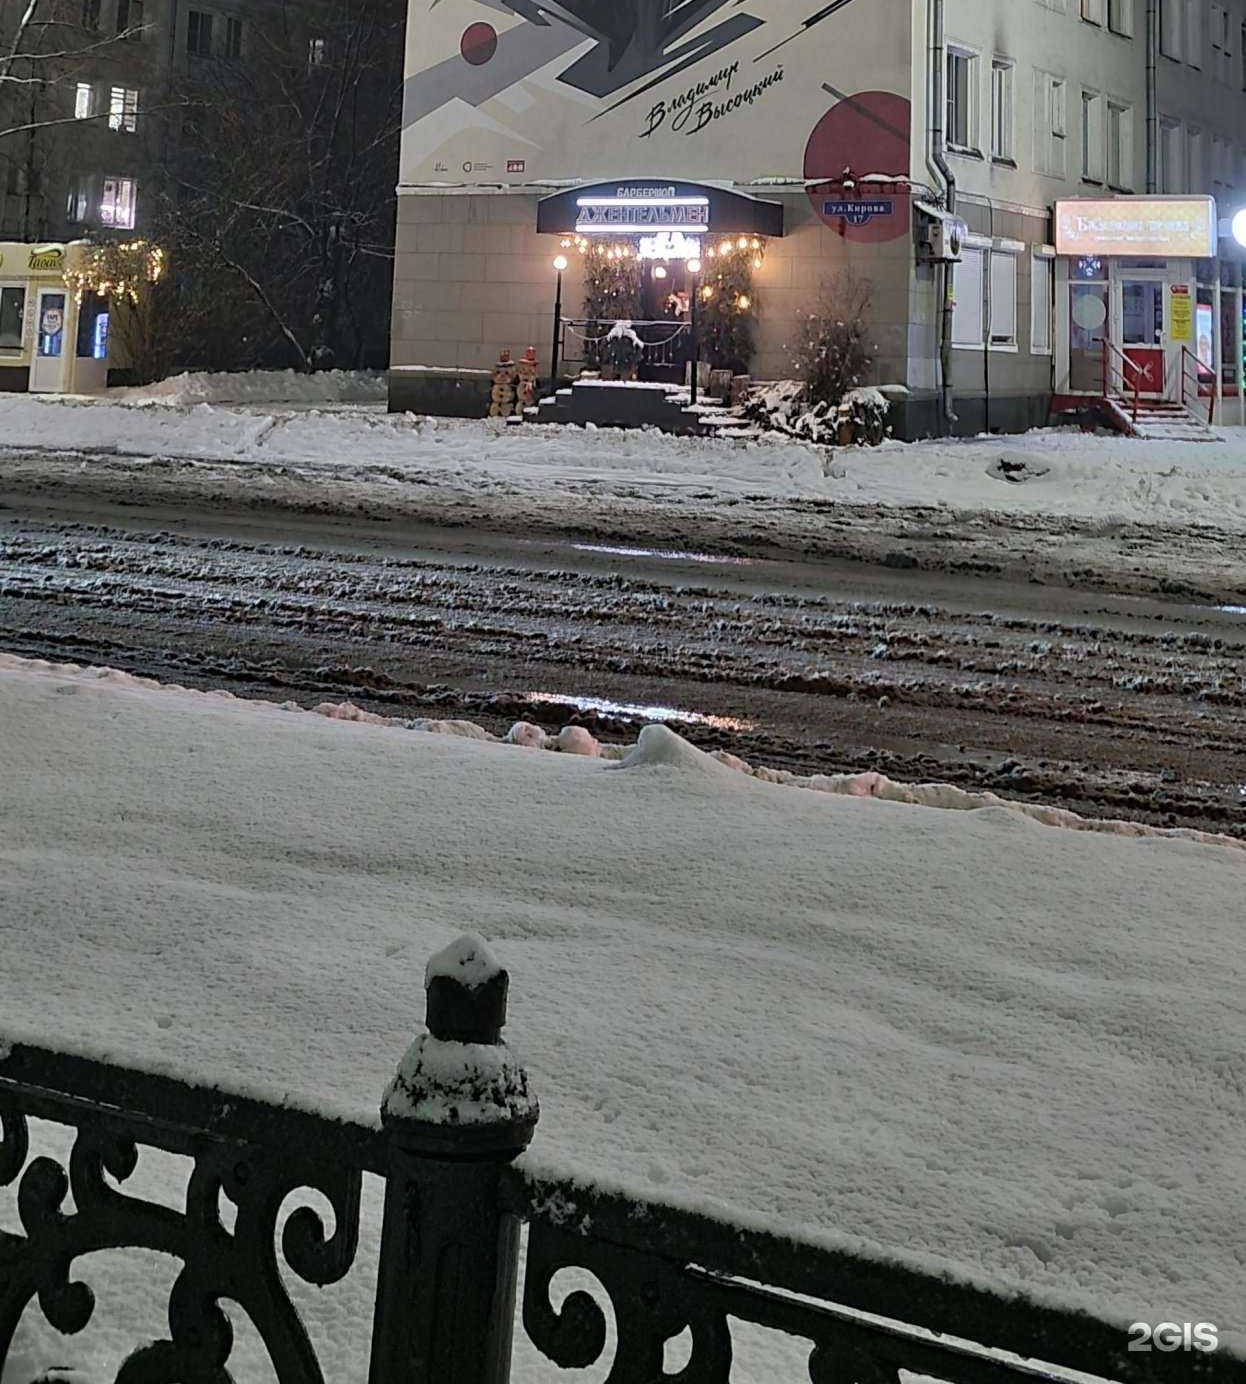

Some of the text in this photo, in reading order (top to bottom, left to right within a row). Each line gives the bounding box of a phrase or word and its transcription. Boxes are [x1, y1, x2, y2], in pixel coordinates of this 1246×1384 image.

[638, 61, 739, 138] Владимир
[685, 64, 784, 136] Высоцкий
[616, 186, 676, 198] БАРБЕРШОП
[577, 206, 709, 225] ДЖЕНТЕЛЬМЕН
[853, 215, 864, 223] 17
